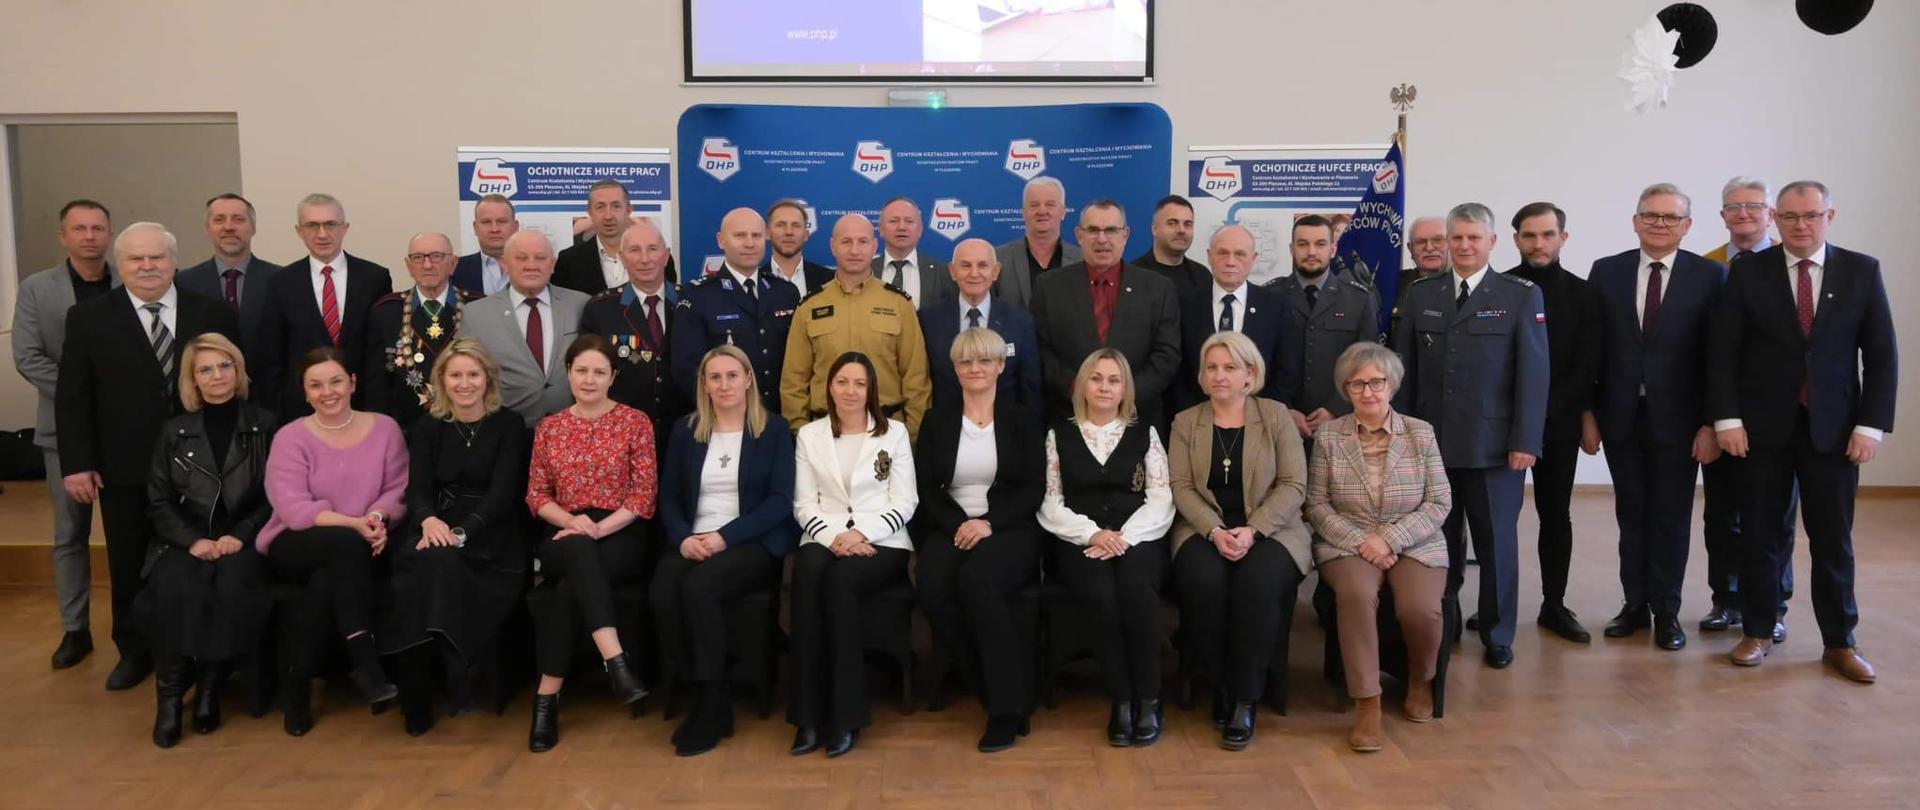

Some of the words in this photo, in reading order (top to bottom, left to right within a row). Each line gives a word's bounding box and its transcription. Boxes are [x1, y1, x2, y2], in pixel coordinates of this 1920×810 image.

[705, 161, 734, 170] OHP
[860, 163, 888, 172] OHP
[1012, 161, 1040, 171] OHP
[1252, 164, 1316, 173] OCHOTNICZE
[1318, 164, 1352, 172] HUFCE
[1354, 163, 1381, 173] PRAC
[527, 166, 593, 176] OCHOTNICZE
[594, 167, 627, 176] HUFCE
[630, 167, 661, 176] PRACY
[479, 184, 512, 193] OHP
[1206, 181, 1237, 190] OHP
[937, 220, 965, 230] OHP
